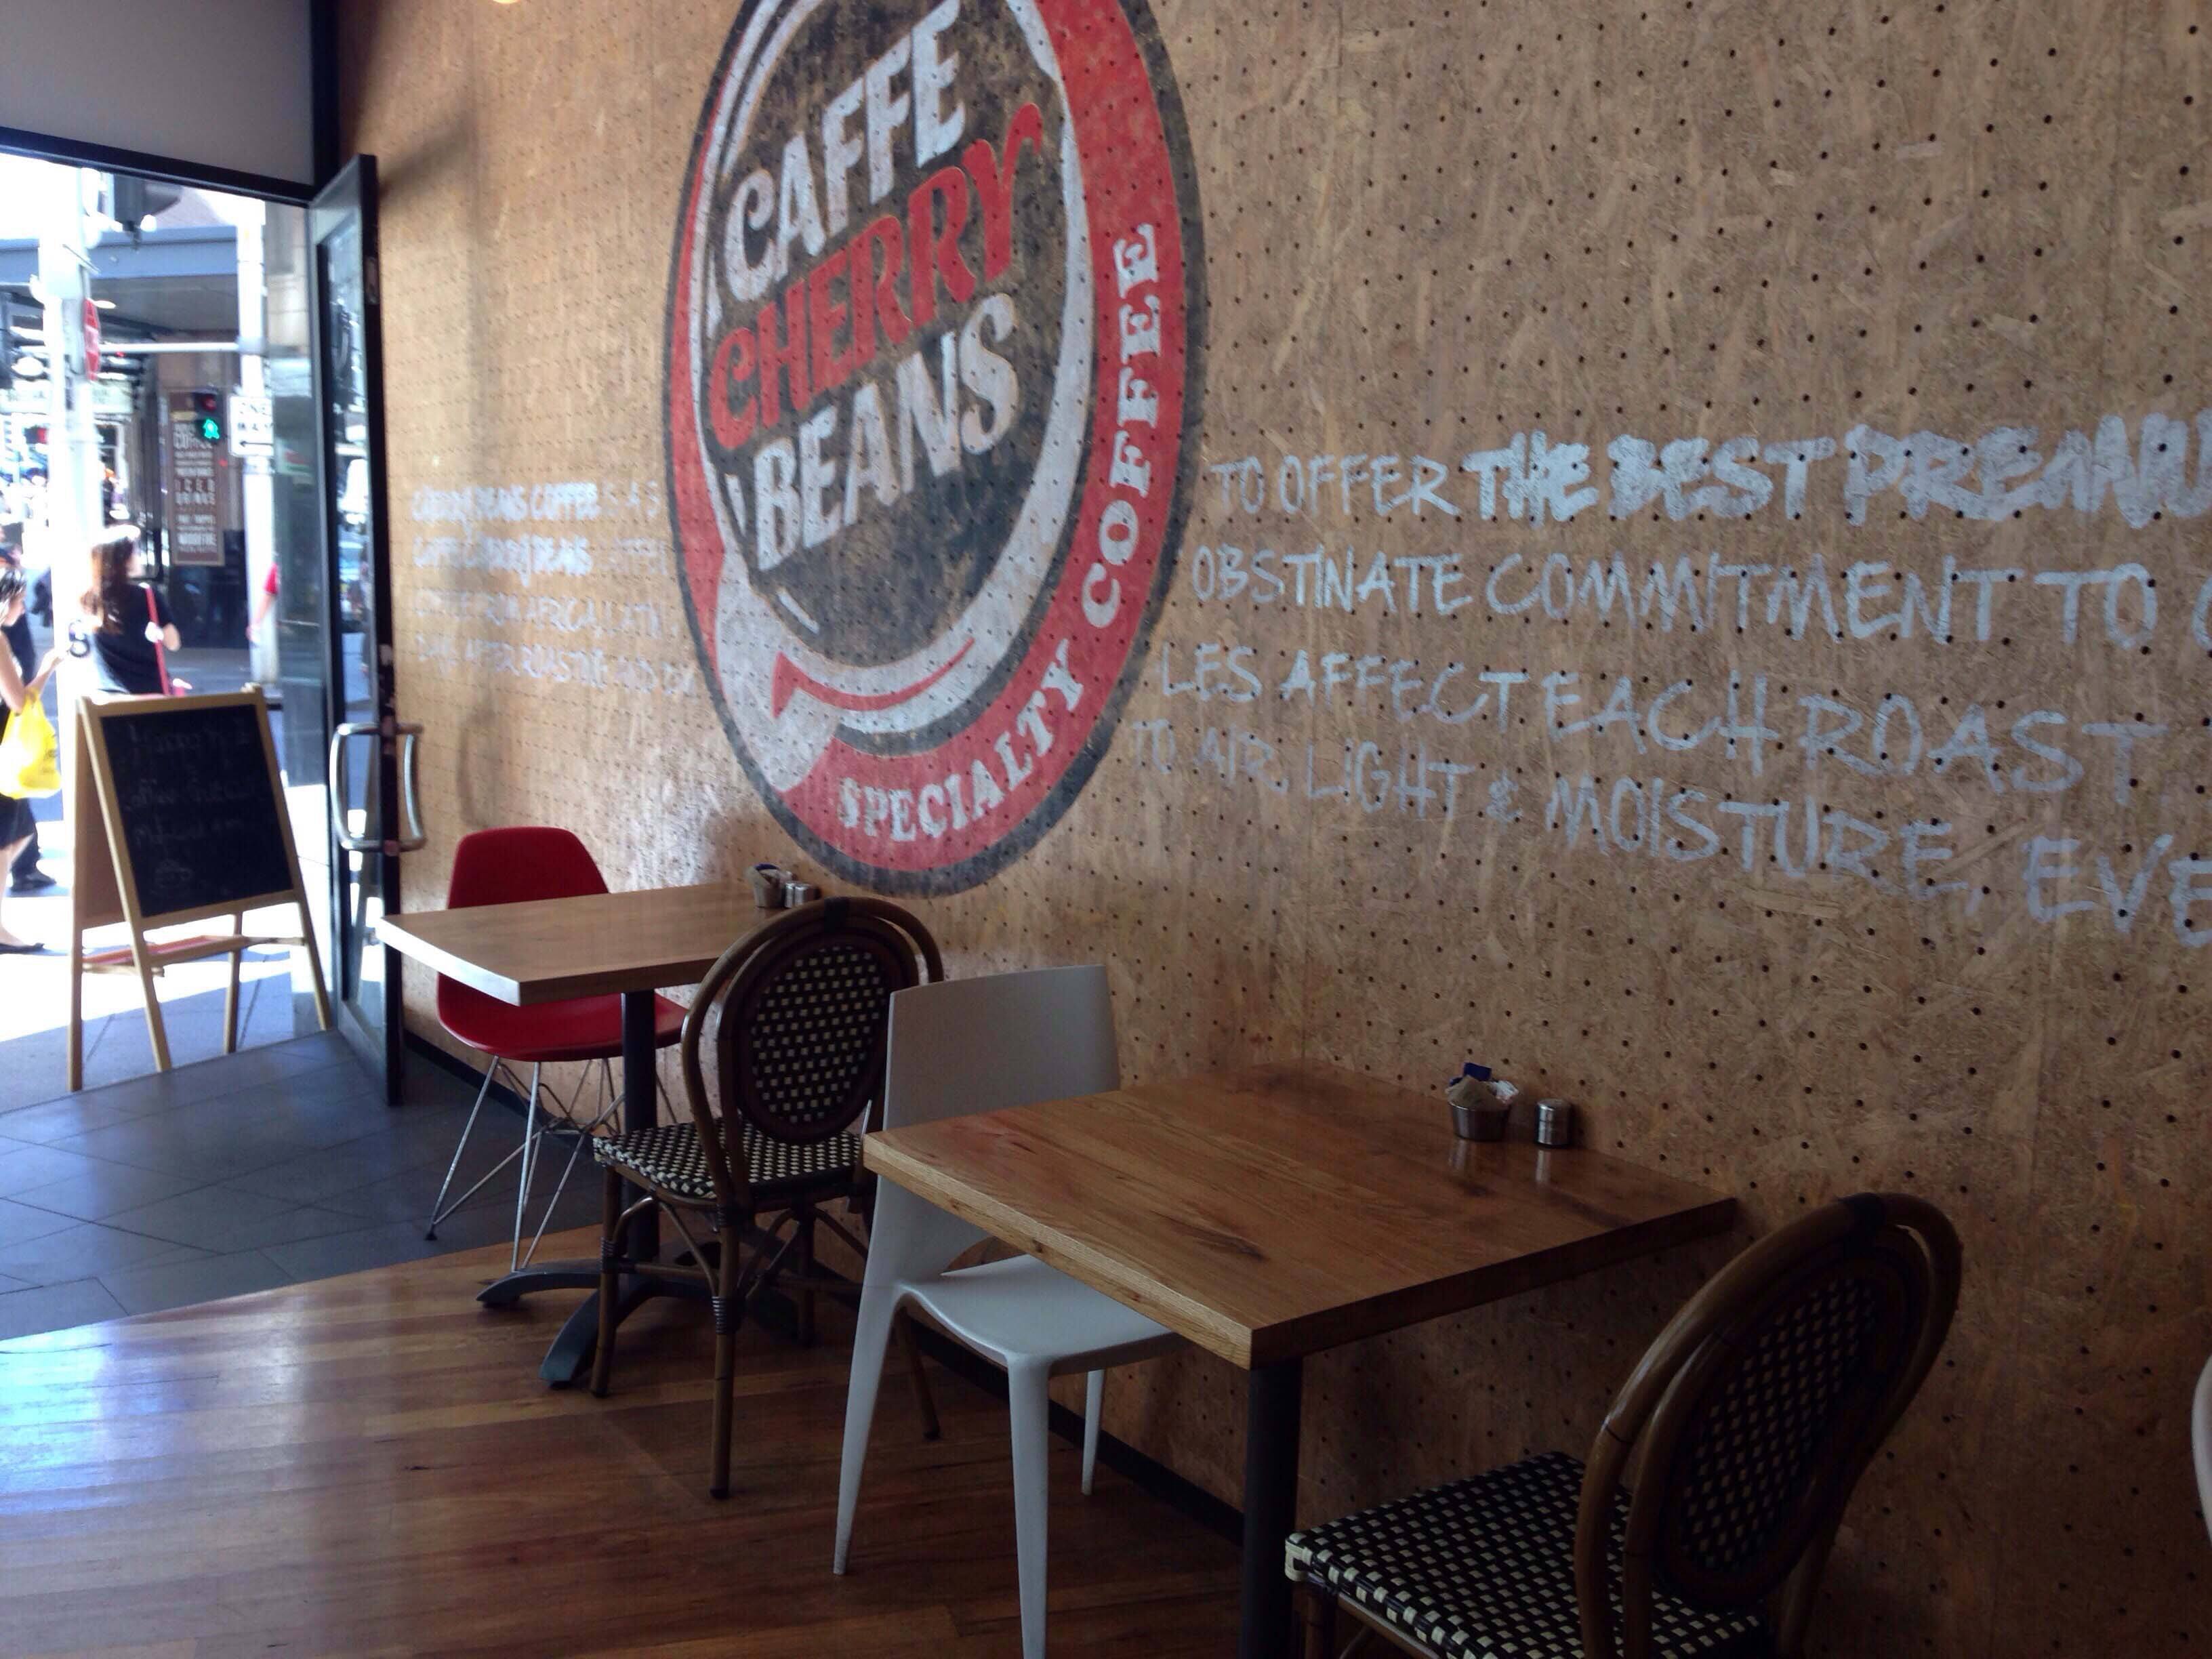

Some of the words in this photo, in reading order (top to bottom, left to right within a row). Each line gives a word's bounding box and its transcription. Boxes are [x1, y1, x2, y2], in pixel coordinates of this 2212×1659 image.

[722, 0, 966, 302] CAFFE
[708, 102, 1043, 450] CHERRY
[753, 293, 1019, 571] BEANS
[838, 638, 1084, 842] SPECIALTY
[1082, 224, 1162, 628] COFFEE
[1210, 455, 1264, 514] TO
[1279, 453, 1462, 517] OFFER
[1460, 430, 1599, 529] THE
[1607, 433, 1837, 522] BEST
[1191, 544, 1474, 616] OBSTINATE
[1485, 552, 2026, 642] COMMITMENT
[2034, 562, 2158, 649] TO
[1160, 640, 1262, 703] LES
[1279, 649, 1530, 735] AFFECT
[1541, 669, 1780, 778] EACH
[1797, 693, 2170, 807] ROAST
[1306, 736, 1478, 822] LIGHT
